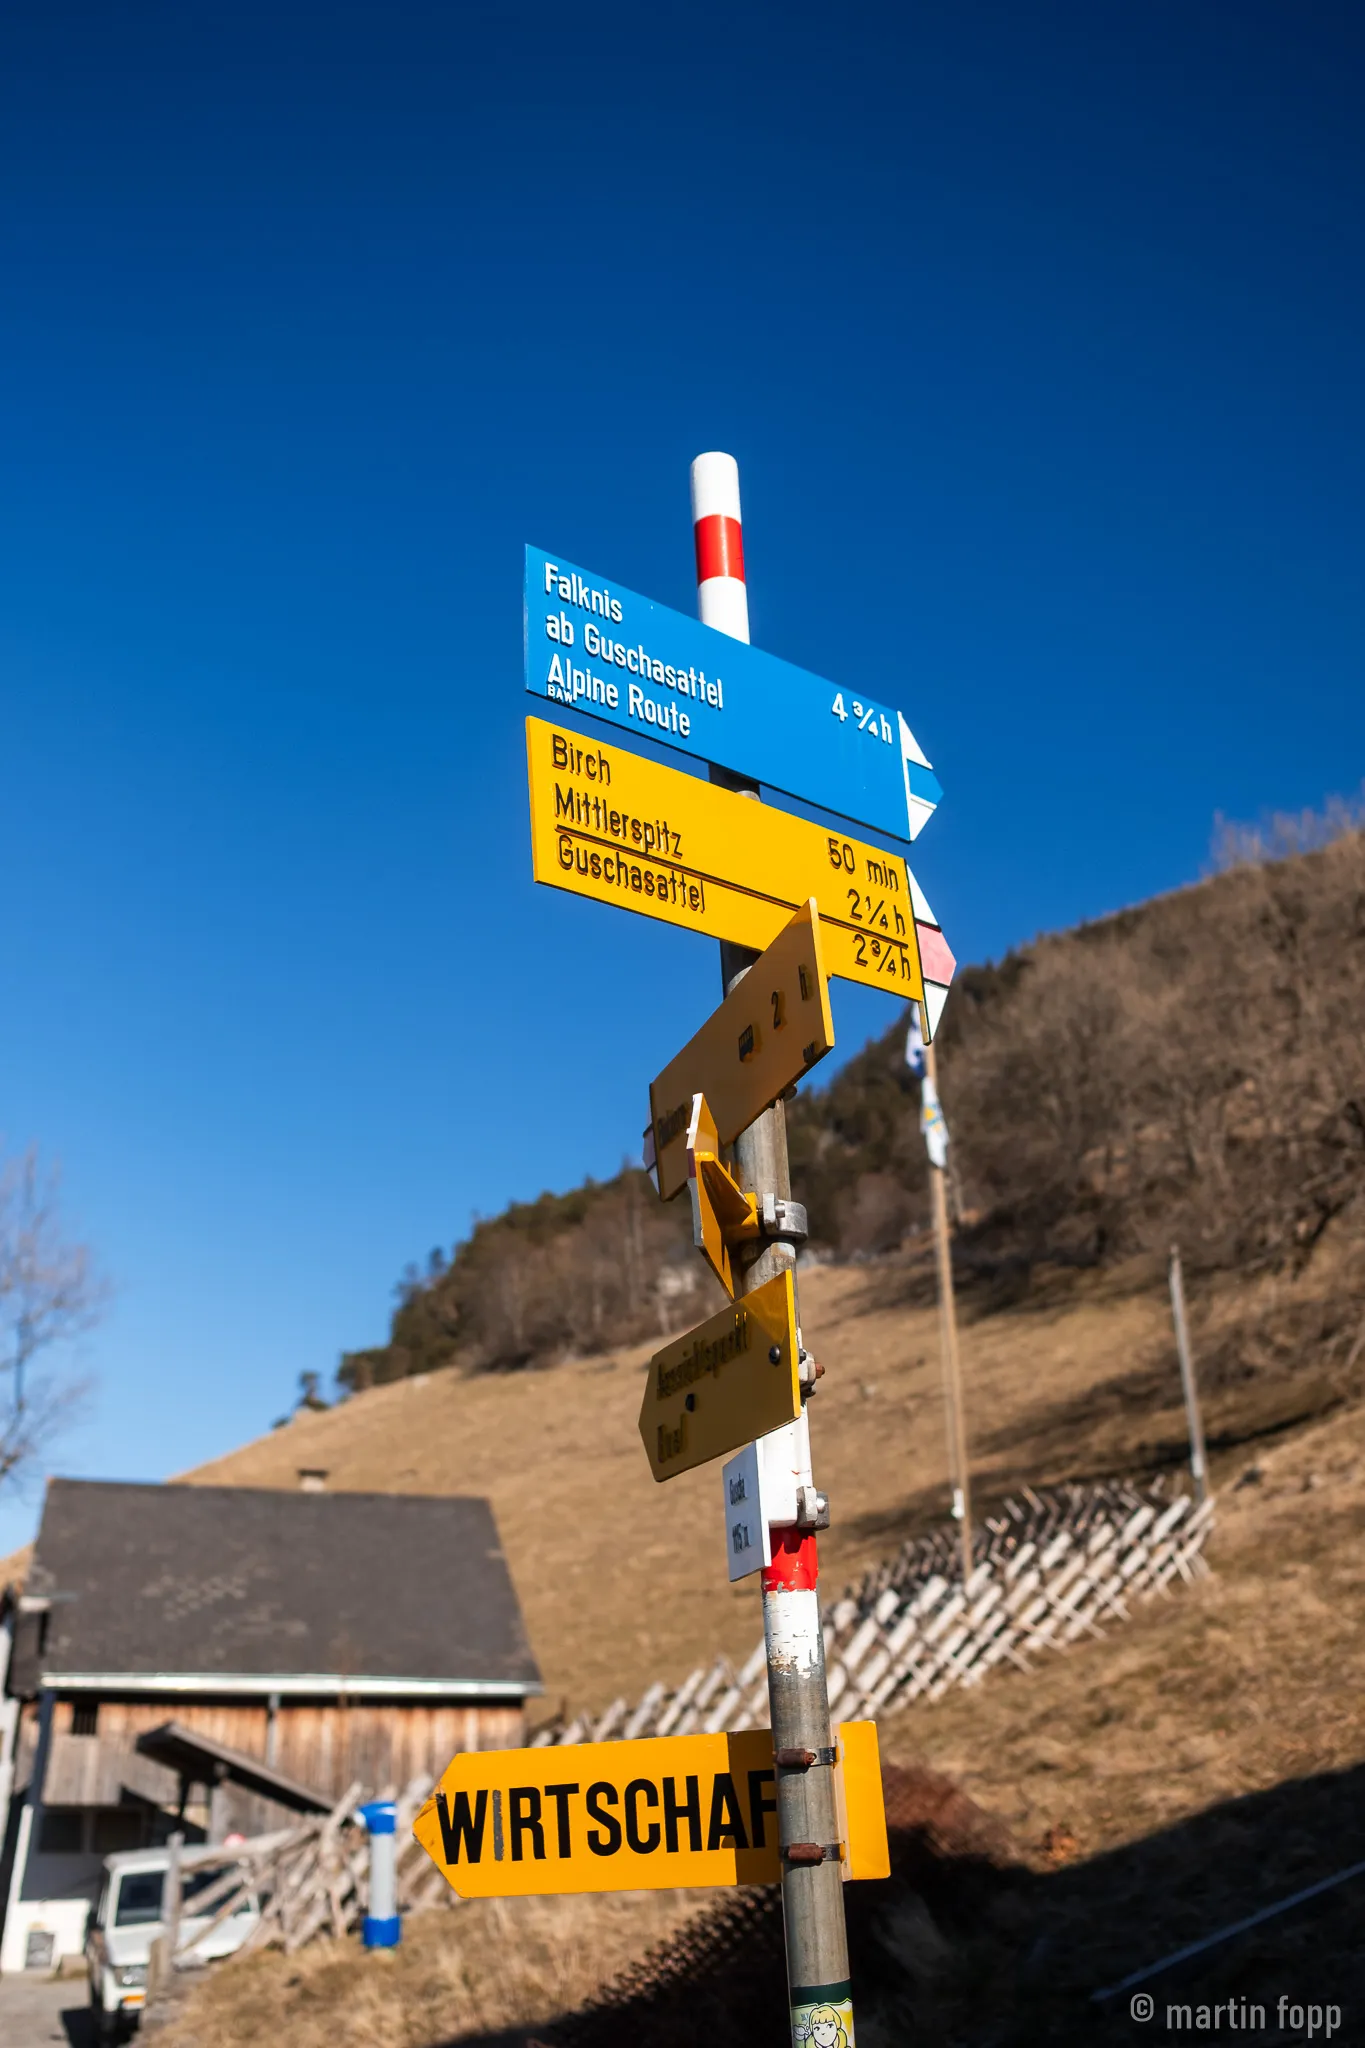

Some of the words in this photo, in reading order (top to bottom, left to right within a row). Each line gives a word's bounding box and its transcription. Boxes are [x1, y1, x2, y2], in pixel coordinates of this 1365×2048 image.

[544, 562, 623, 623] Falknis
[546, 611, 575, 646] ab
[583, 626, 724, 709] Guschasattel
[547, 684, 574, 704] BAW
[547, 653, 619, 708] Alpine
[628, 683, 691, 737] Route
[551, 733, 612, 786] Birch
[553, 783, 684, 859] Mittlerspitz
[557, 834, 706, 914] Guschasattel
[826, 837, 856, 875] 50
[866, 859, 899, 893] min
